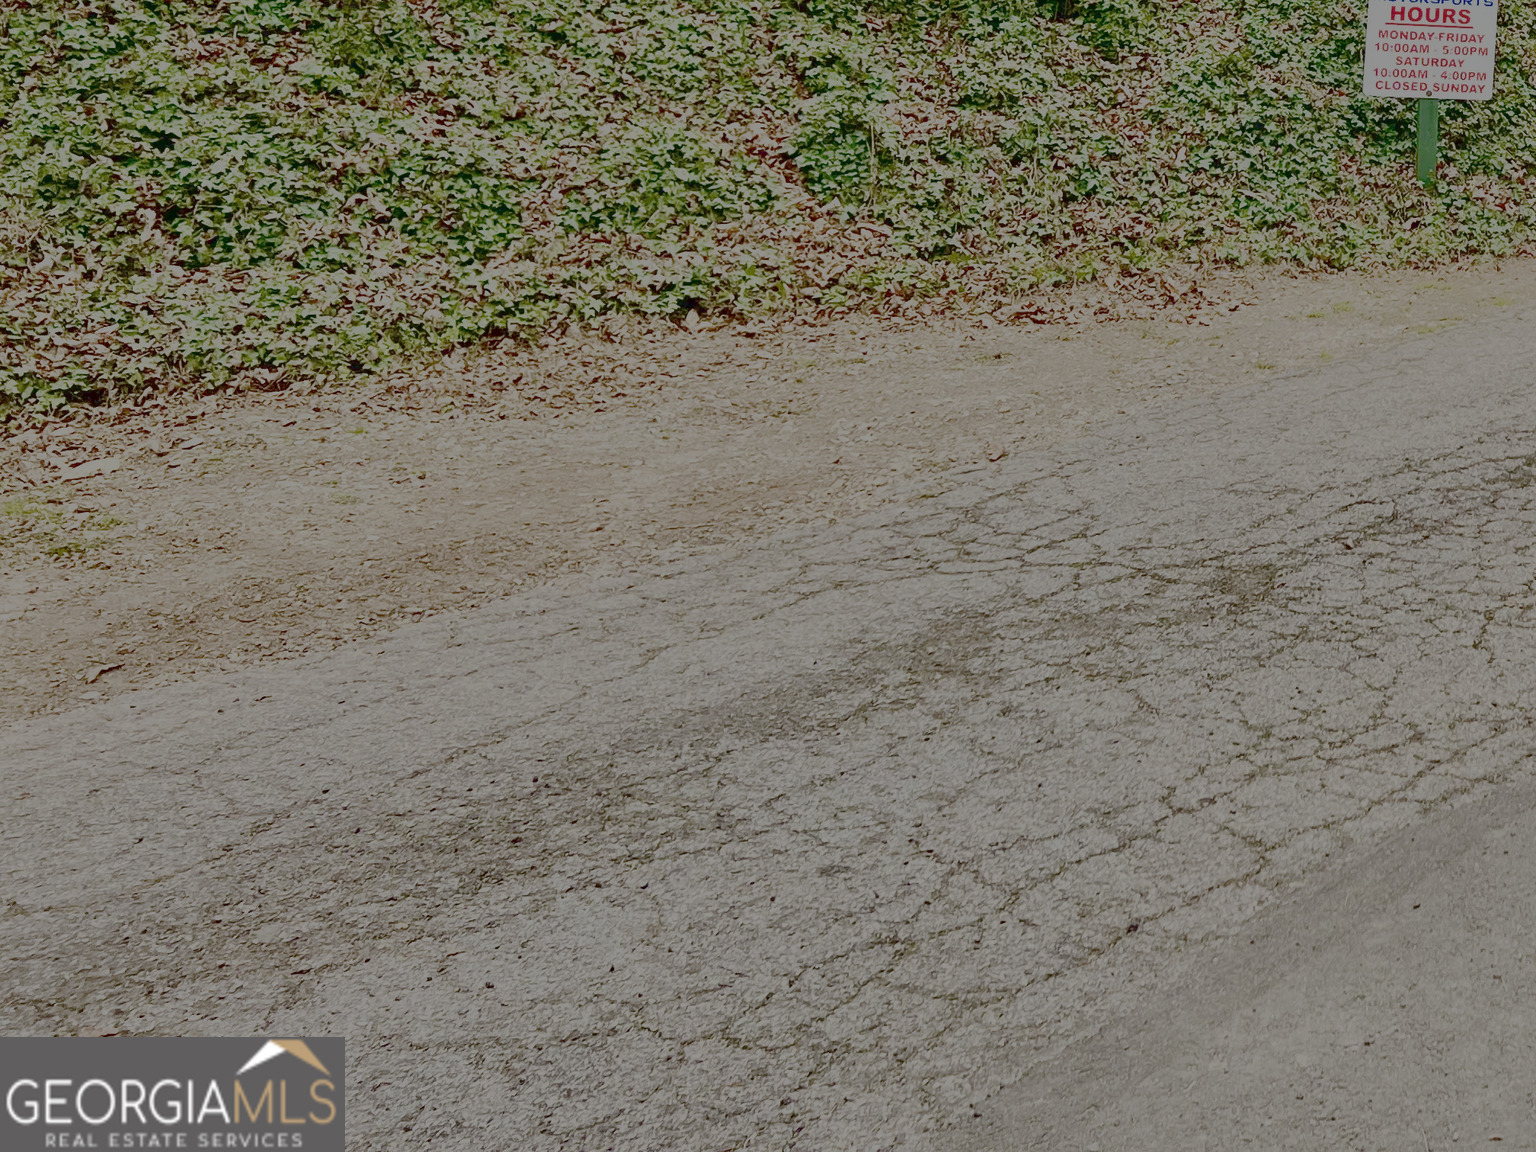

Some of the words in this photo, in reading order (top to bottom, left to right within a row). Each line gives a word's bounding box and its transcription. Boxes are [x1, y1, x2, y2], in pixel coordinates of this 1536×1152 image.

[1390, 6, 1471, 24] HOURS
[1375, 43, 1429, 53] 10:00AM
[1442, 46, 1488, 56] 5:00PM
[1396, 56, 1464, 67] SATURDAY
[1374, 68, 1428, 78] 10:00AM
[1441, 71, 1486, 81] 4:00PM
[1376, 81, 1427, 91] CLOSED
[1433, 83, 1485, 93] SUNDAY
